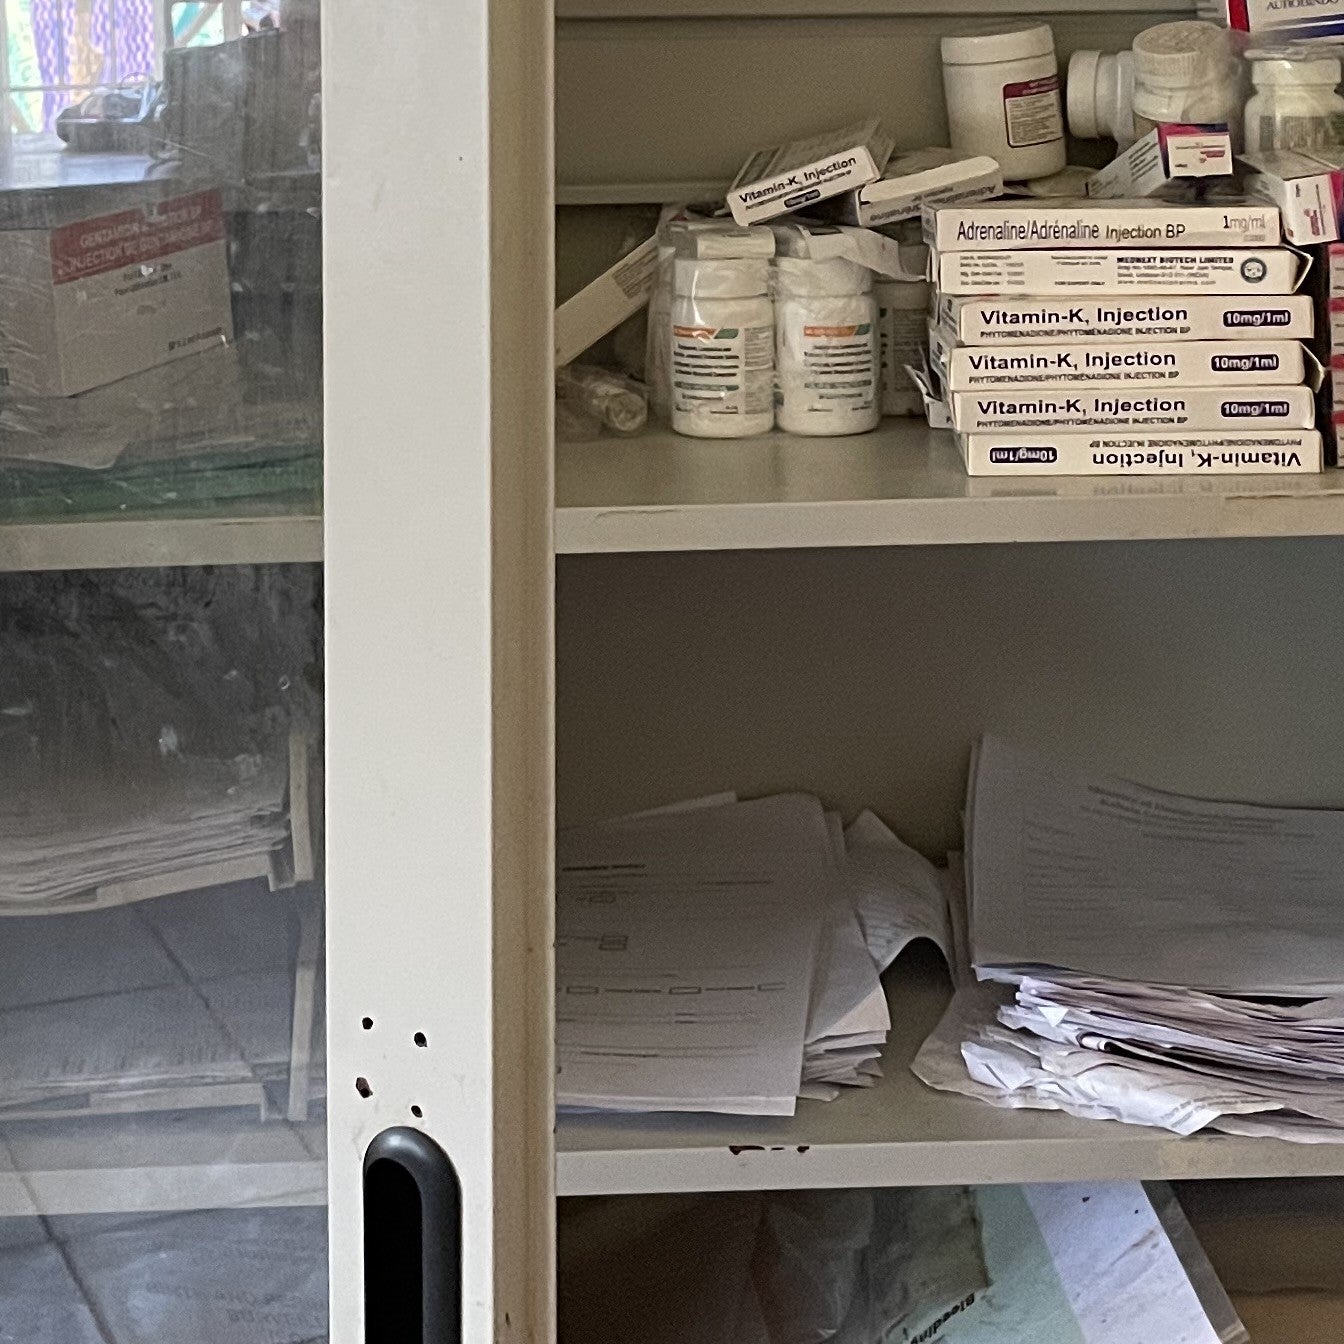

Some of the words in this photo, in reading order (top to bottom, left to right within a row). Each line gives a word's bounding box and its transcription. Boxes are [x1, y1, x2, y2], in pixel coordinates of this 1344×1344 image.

[803, 156, 857, 182] Injection
[957, 218, 1099, 241] Adrenaline/Adrénaline
[1105, 224, 1162, 242] Injection
[1165, 223, 1186, 239] BP
[1222, 214, 1266, 232] 1mg/ml
[1098, 306, 1187, 324] Injection
[1226, 311, 1289, 326] 10mg/1ml
[1085, 351, 1176, 368] Injection
[1214, 356, 1277, 371] 10mg/1ml
[1094, 398, 1185, 414] Injection
[1223, 402, 1288, 417] 10mg/1ml
[992, 448, 1056, 463] 10mg/1ml
[1092, 451, 1184, 468] Injection
